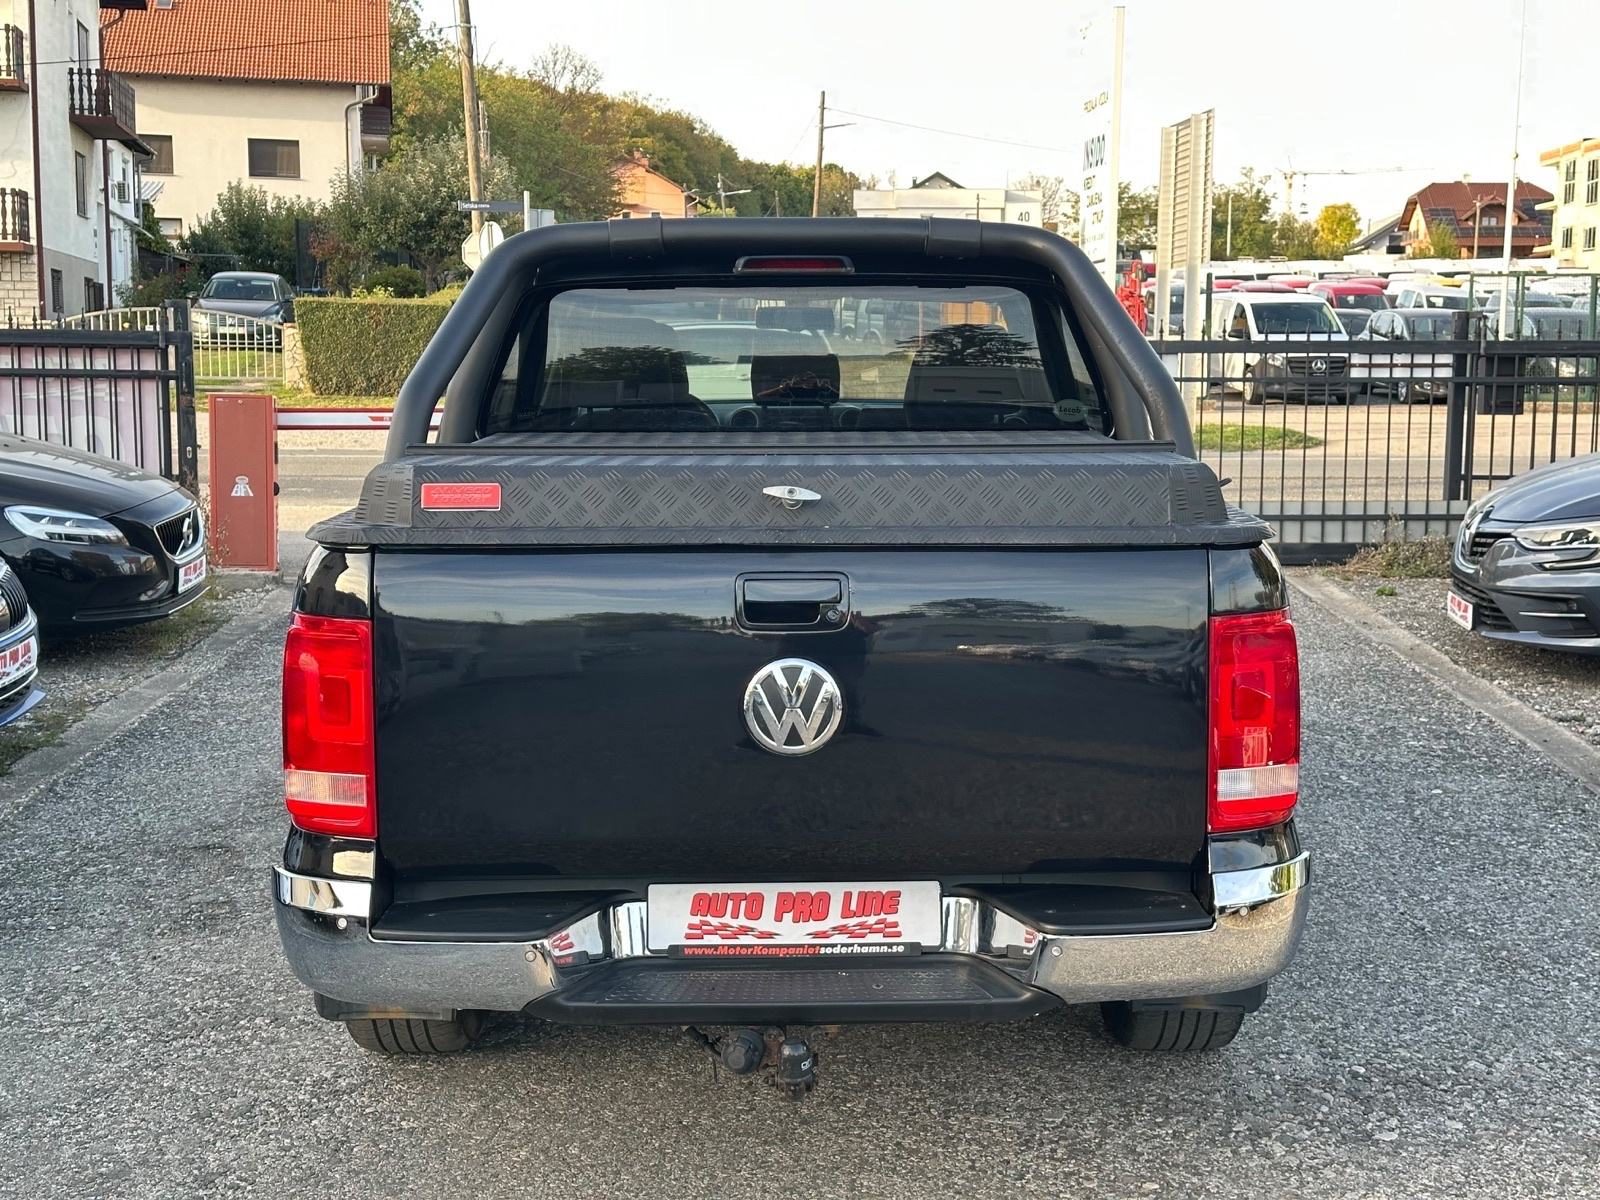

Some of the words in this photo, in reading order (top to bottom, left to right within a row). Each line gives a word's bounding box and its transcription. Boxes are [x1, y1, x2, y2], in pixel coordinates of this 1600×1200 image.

[1017, 211, 1030, 222] 40
[690, 891, 764, 920] AUTO
[774, 891, 831, 923] PRO
[841, 890, 901, 919] LINE
